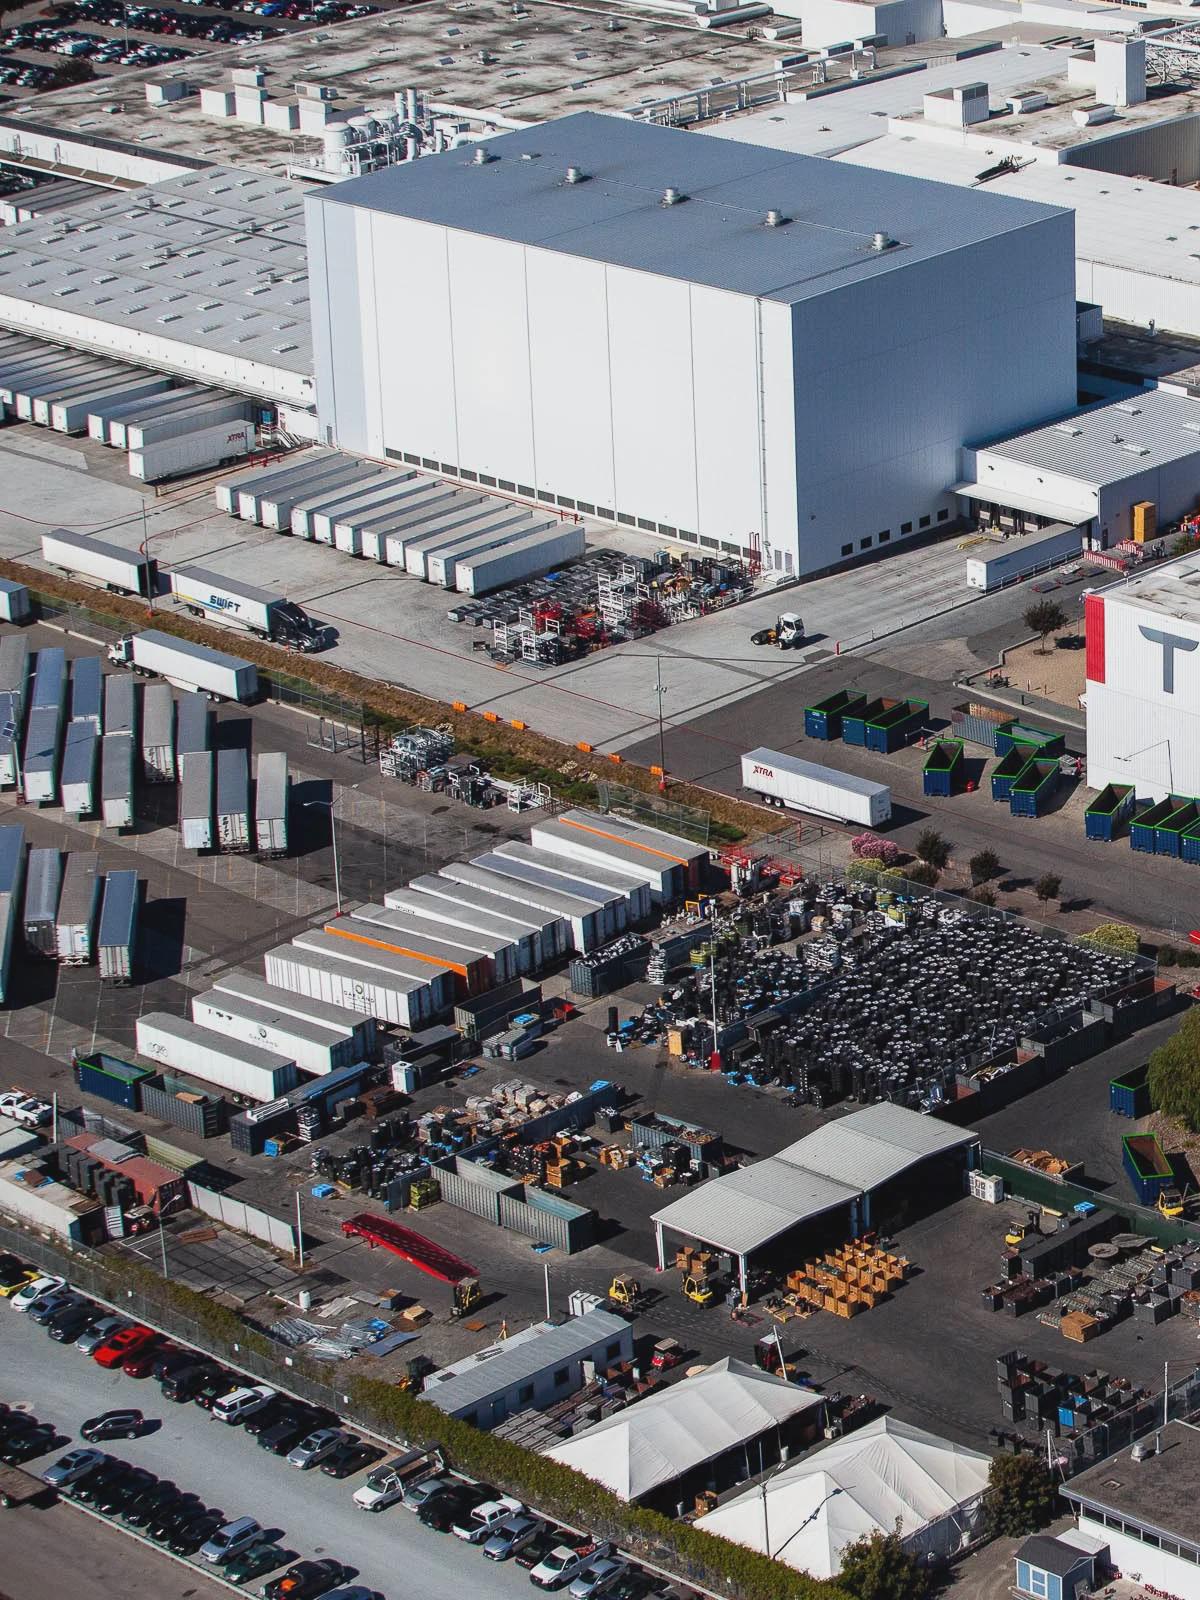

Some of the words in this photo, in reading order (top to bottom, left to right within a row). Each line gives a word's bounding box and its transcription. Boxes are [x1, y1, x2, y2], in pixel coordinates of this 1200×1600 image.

[227, 432, 244, 443] XTRA
[210, 595, 241, 612] SWIFT
[753, 765, 773, 778] XTRA
